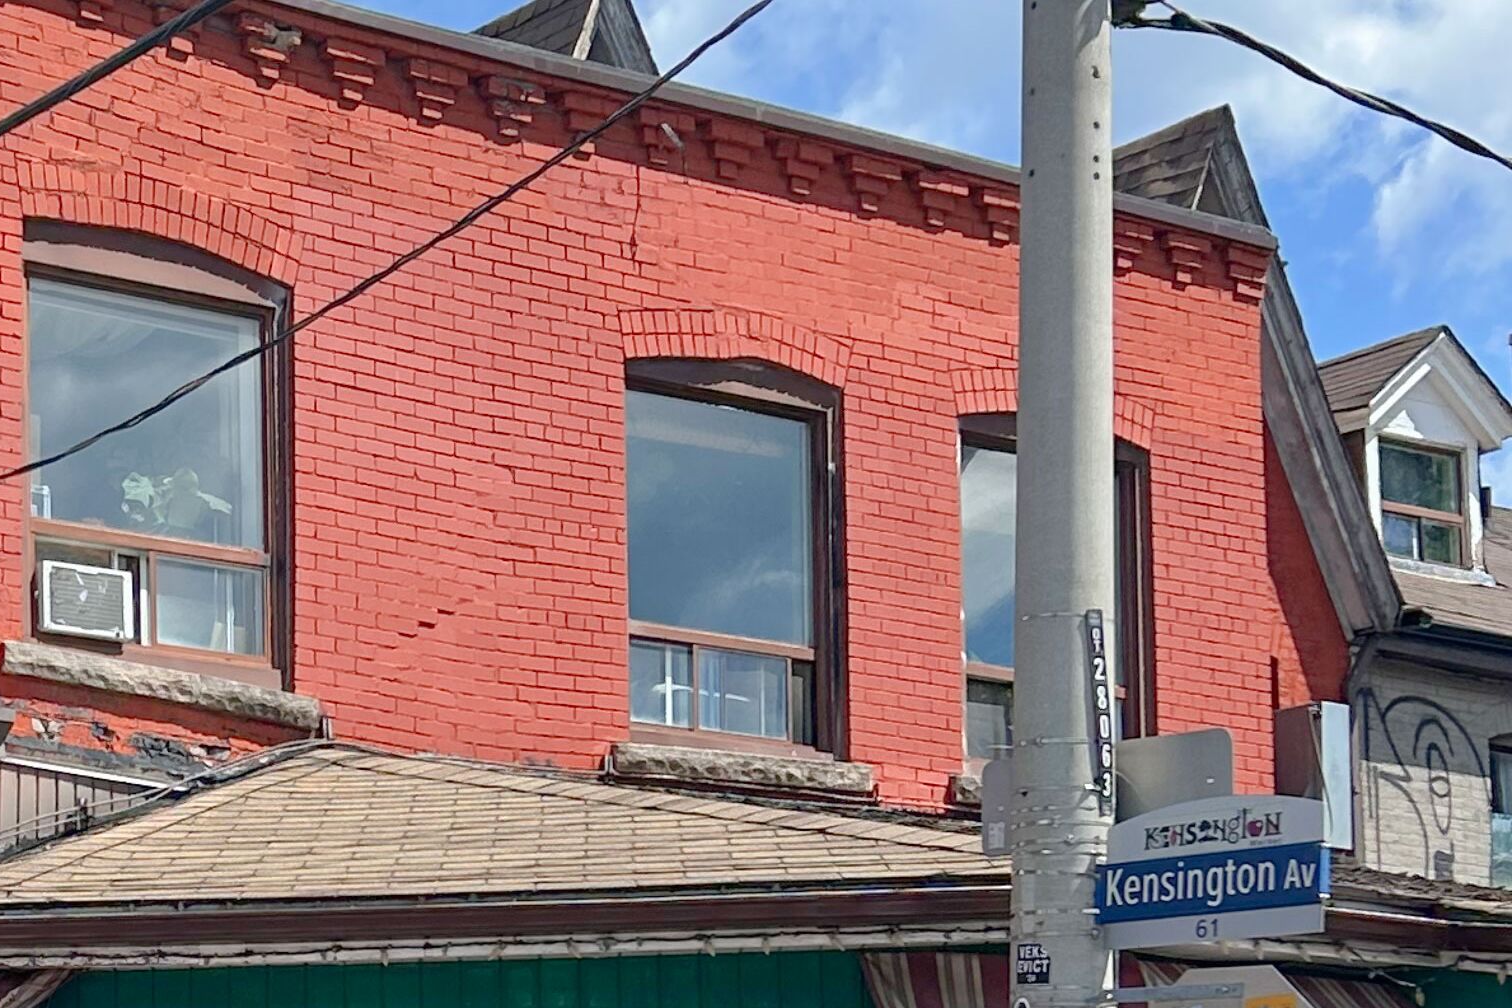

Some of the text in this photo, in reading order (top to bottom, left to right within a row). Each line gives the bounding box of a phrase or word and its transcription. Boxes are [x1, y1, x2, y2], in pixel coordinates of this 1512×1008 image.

[1092, 657, 1112, 797] 28063
[1106, 858, 1317, 907] Kensington Av
[1196, 918, 1219, 939] 61
